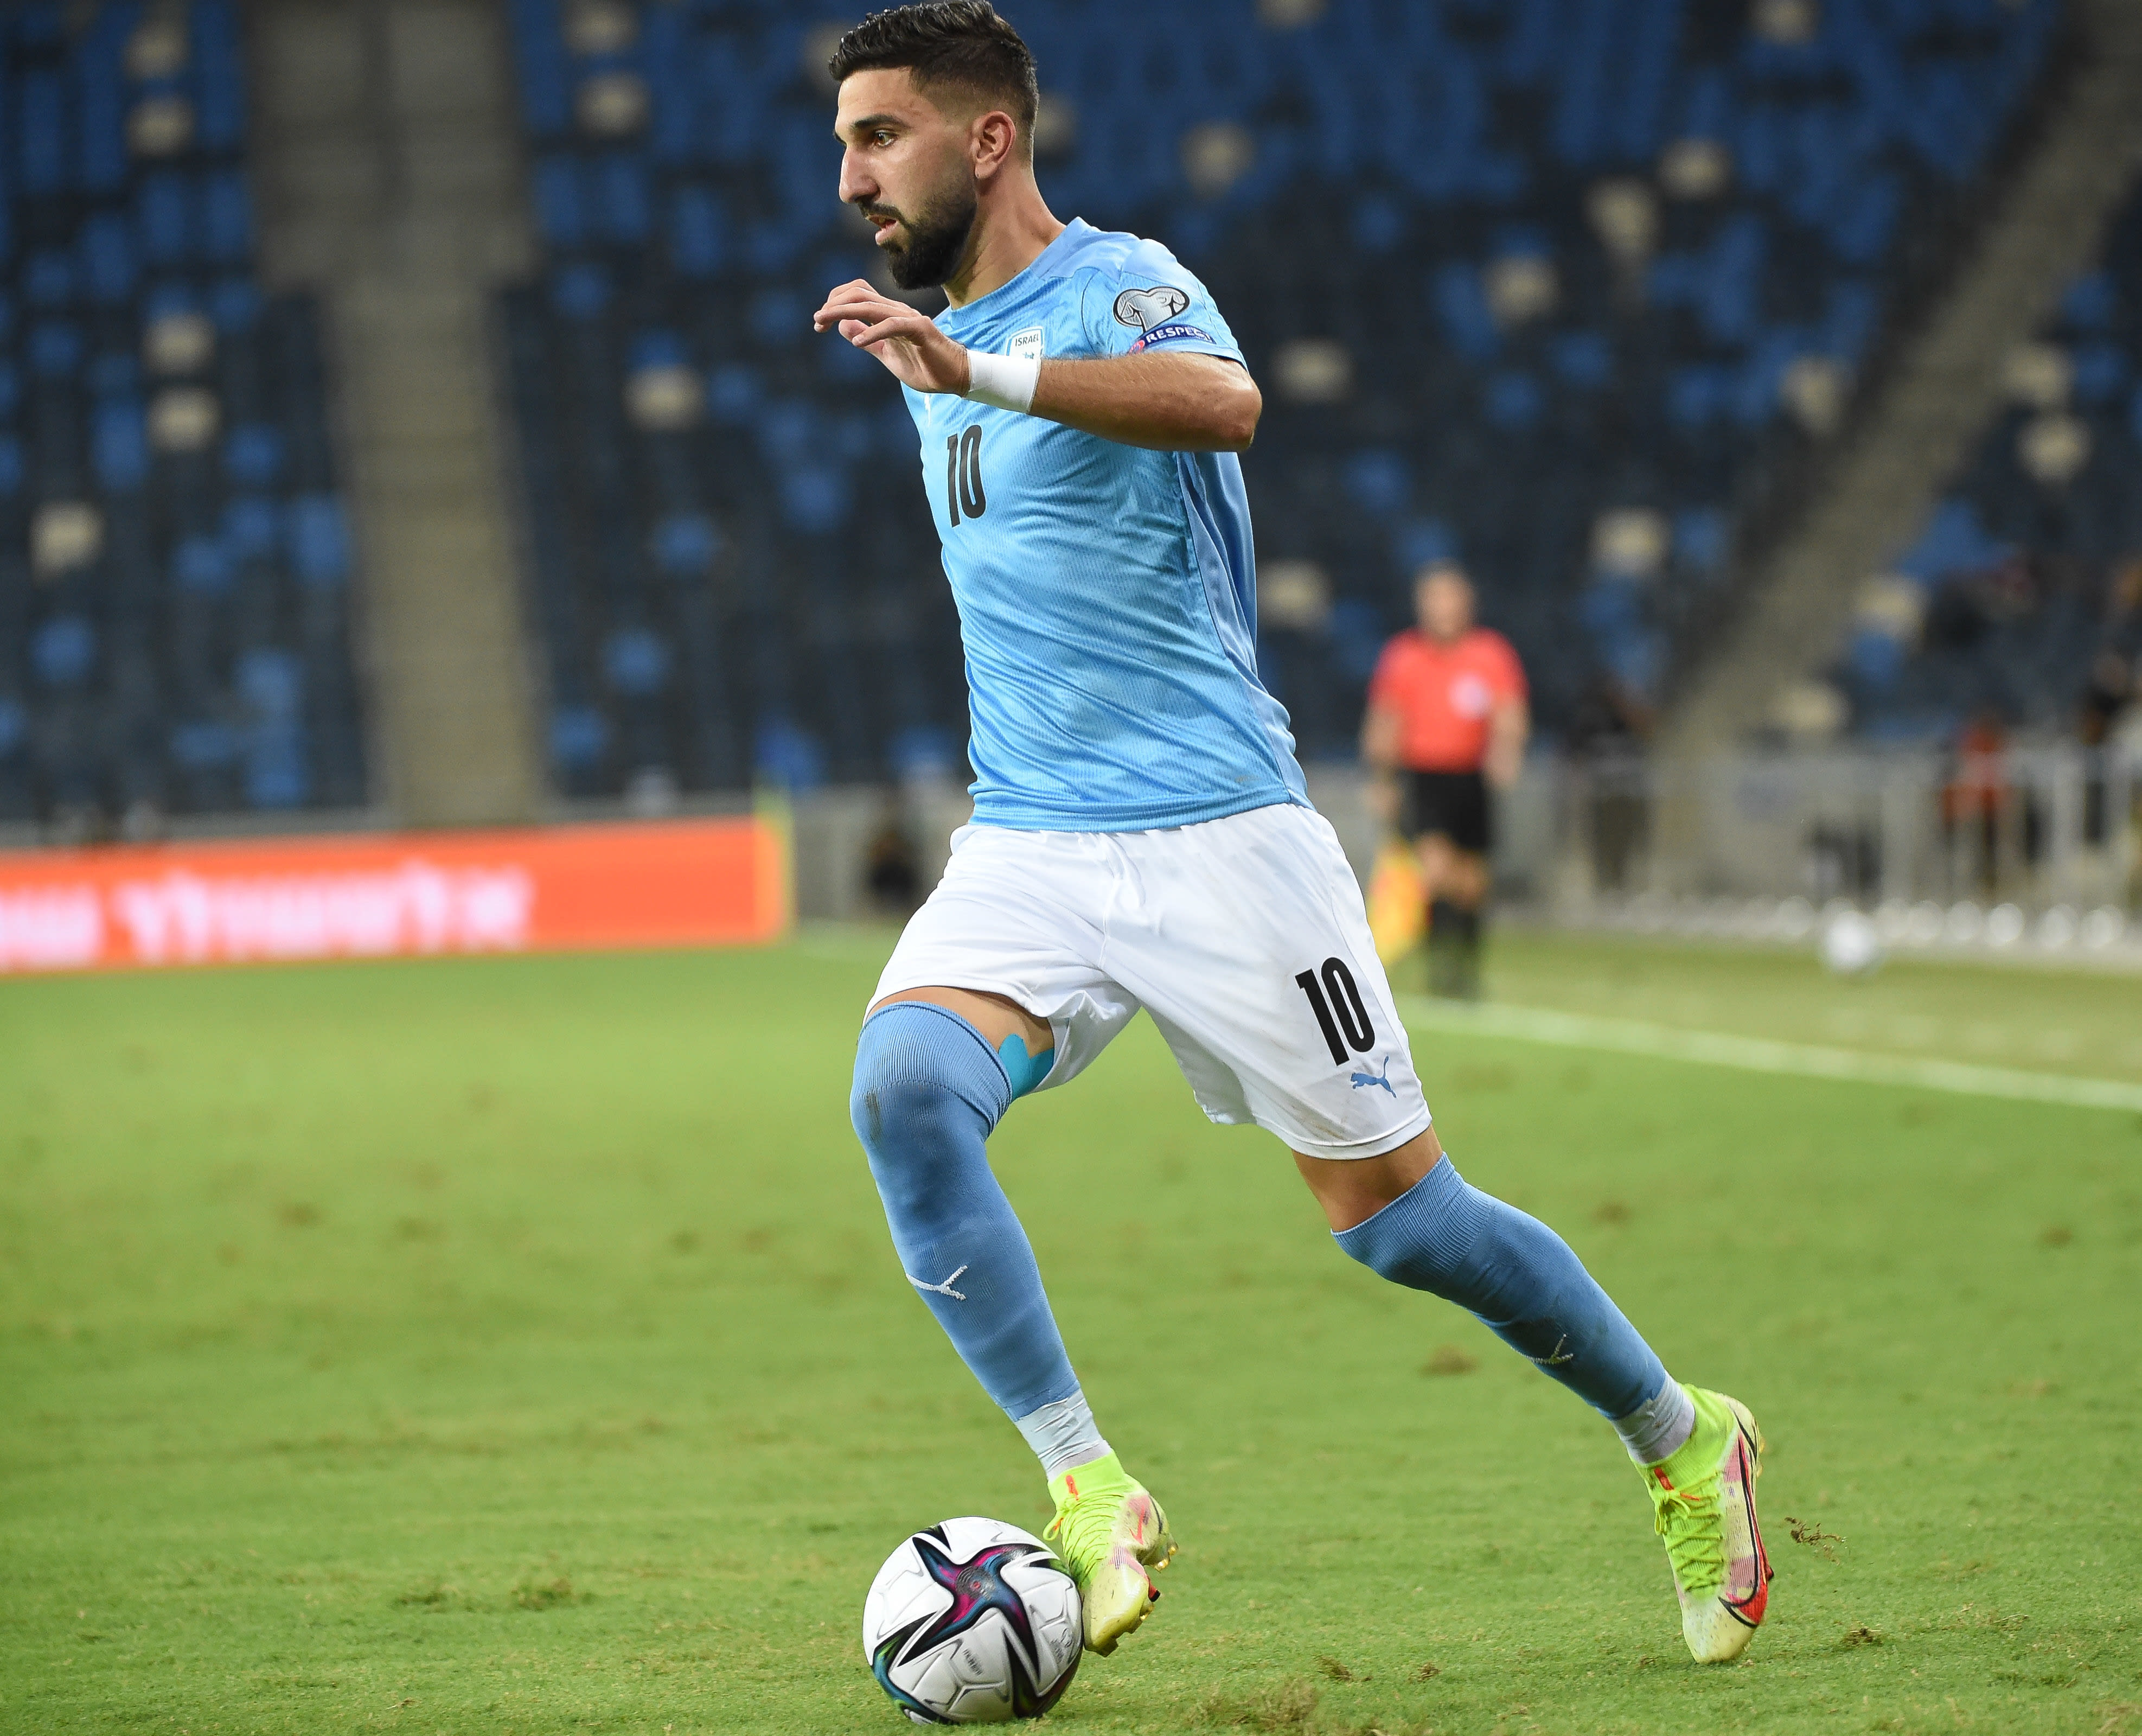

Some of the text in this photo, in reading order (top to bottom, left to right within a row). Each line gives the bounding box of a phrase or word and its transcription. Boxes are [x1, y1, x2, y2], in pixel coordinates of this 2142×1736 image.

[1015, 334, 1039, 347] ISRAEL
[947, 425, 986, 527] 10
[1294, 956, 1376, 1067] 10
